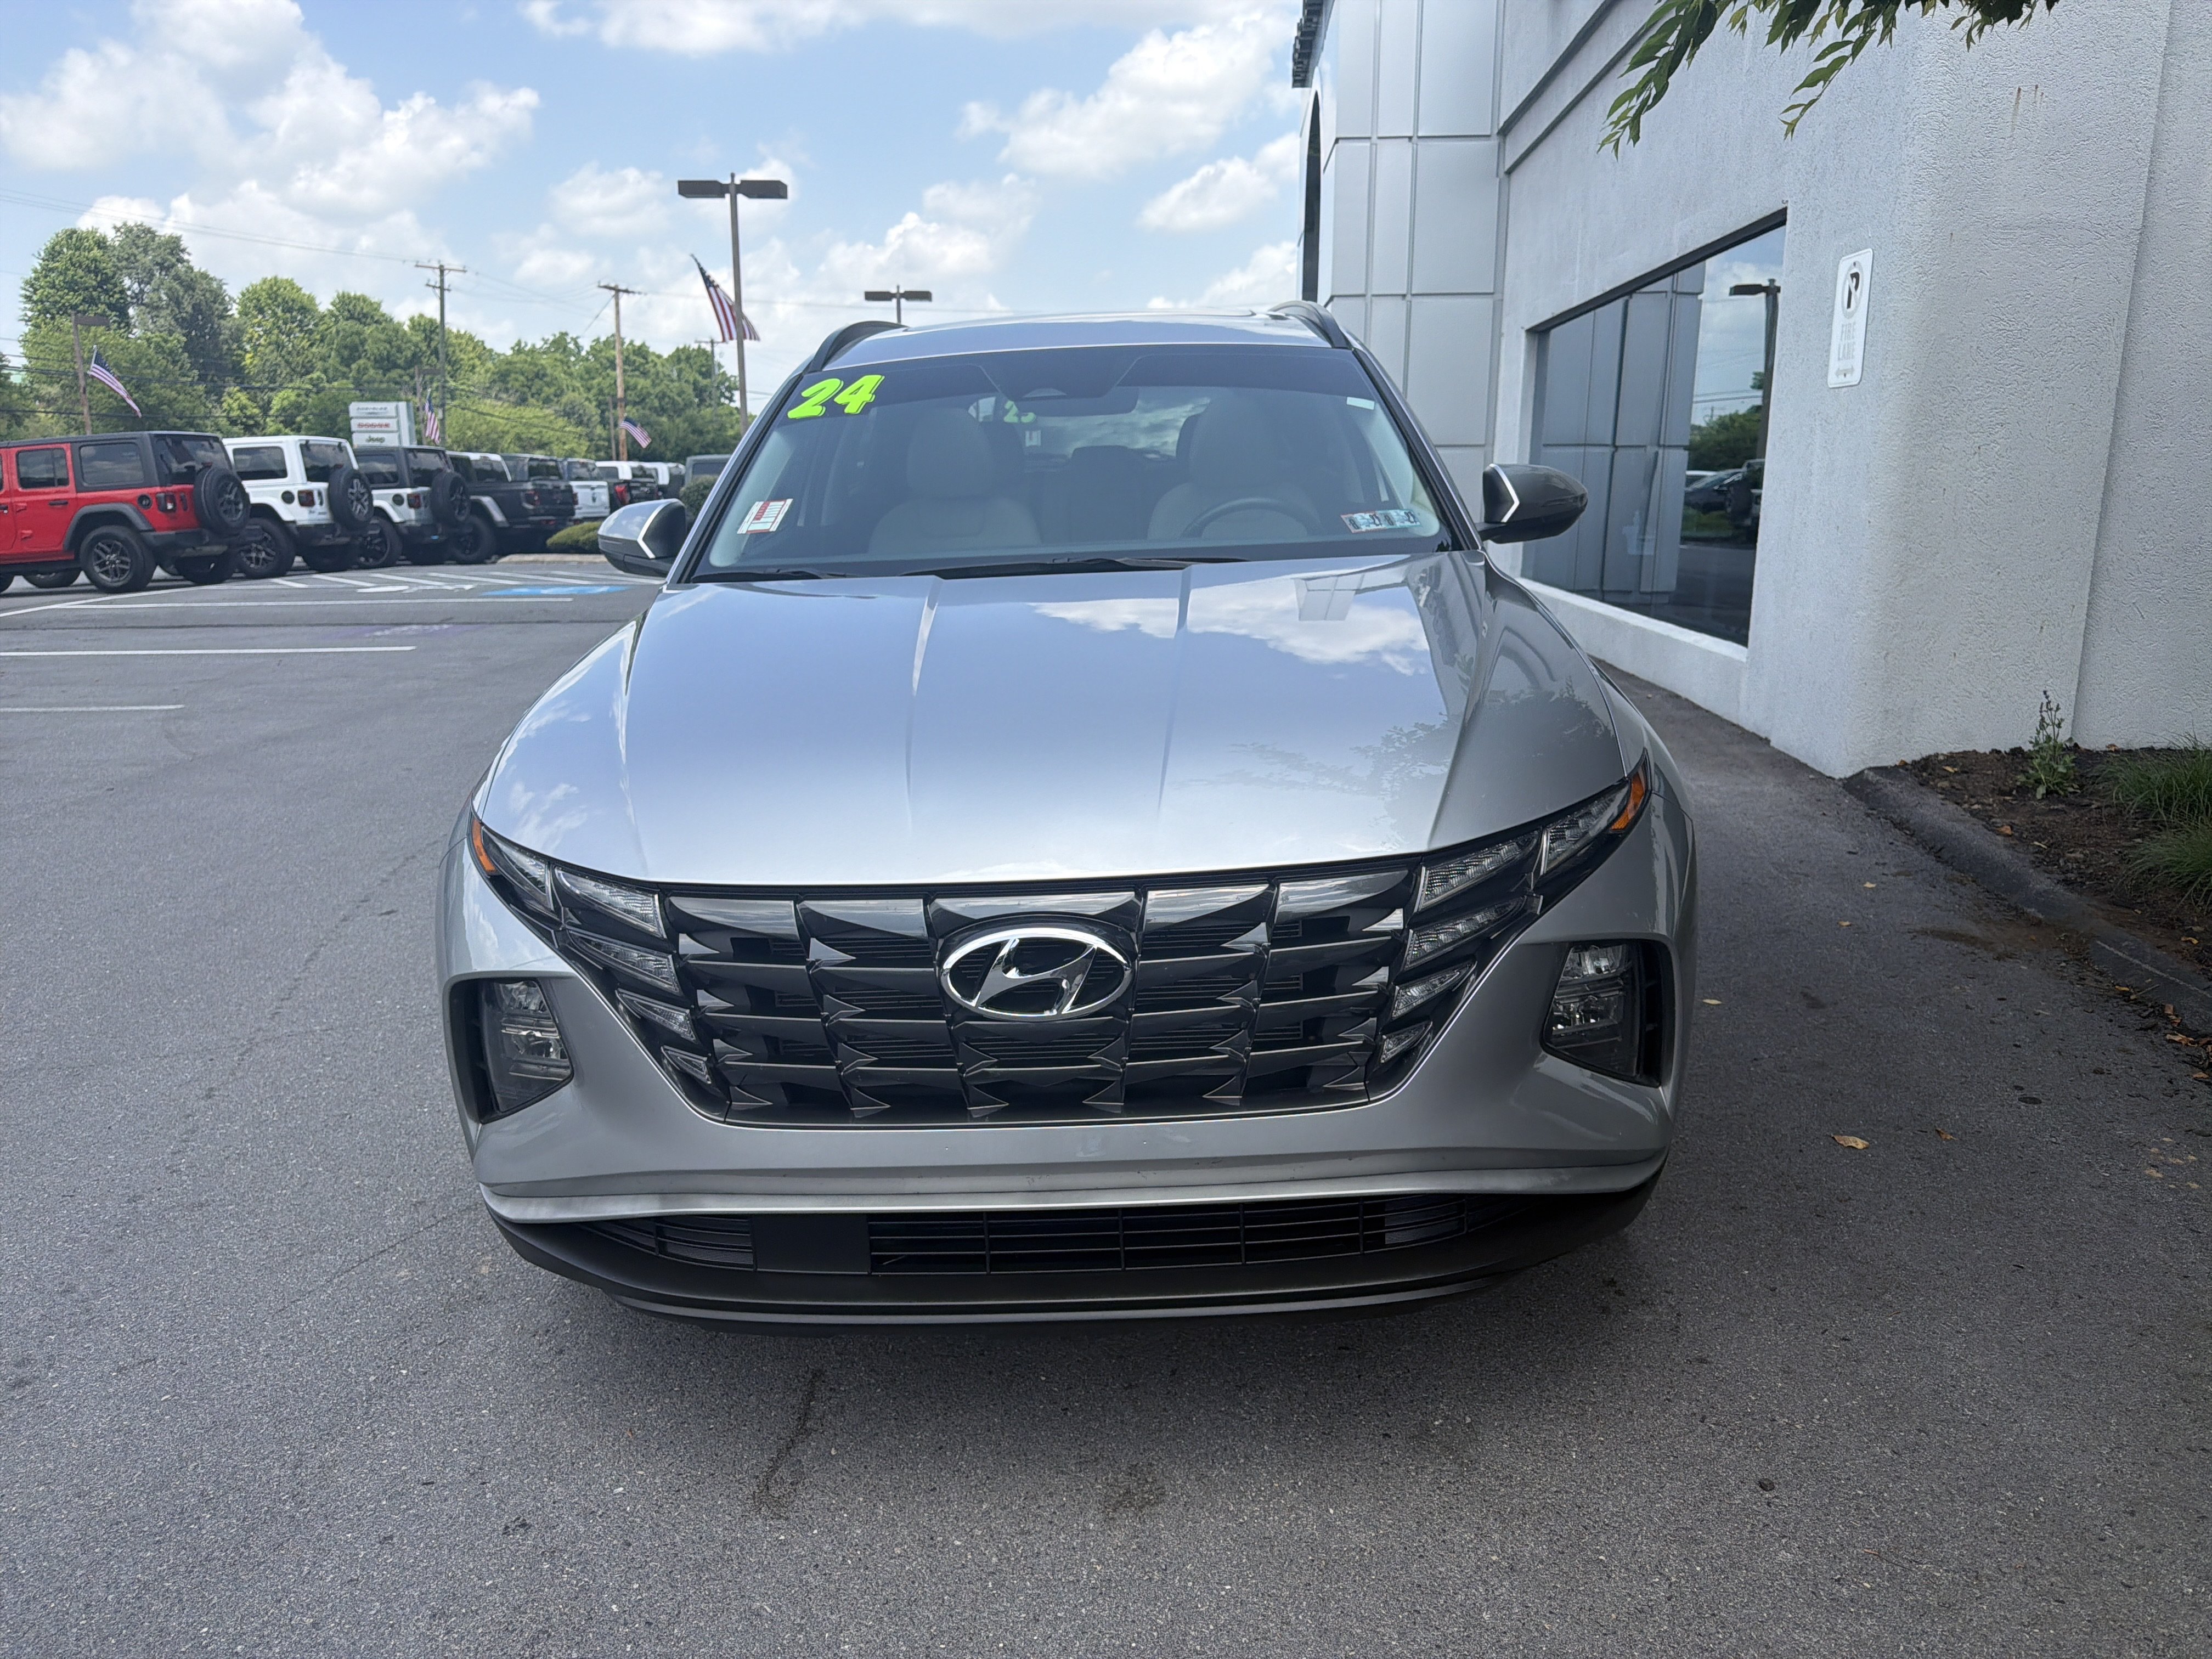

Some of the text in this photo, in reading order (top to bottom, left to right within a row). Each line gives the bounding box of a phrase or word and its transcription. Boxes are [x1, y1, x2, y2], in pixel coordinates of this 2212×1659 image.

[1840, 321, 1856, 341] FIRE
[1837, 341, 1855, 362] LANE
[787, 375, 885, 419] 24
